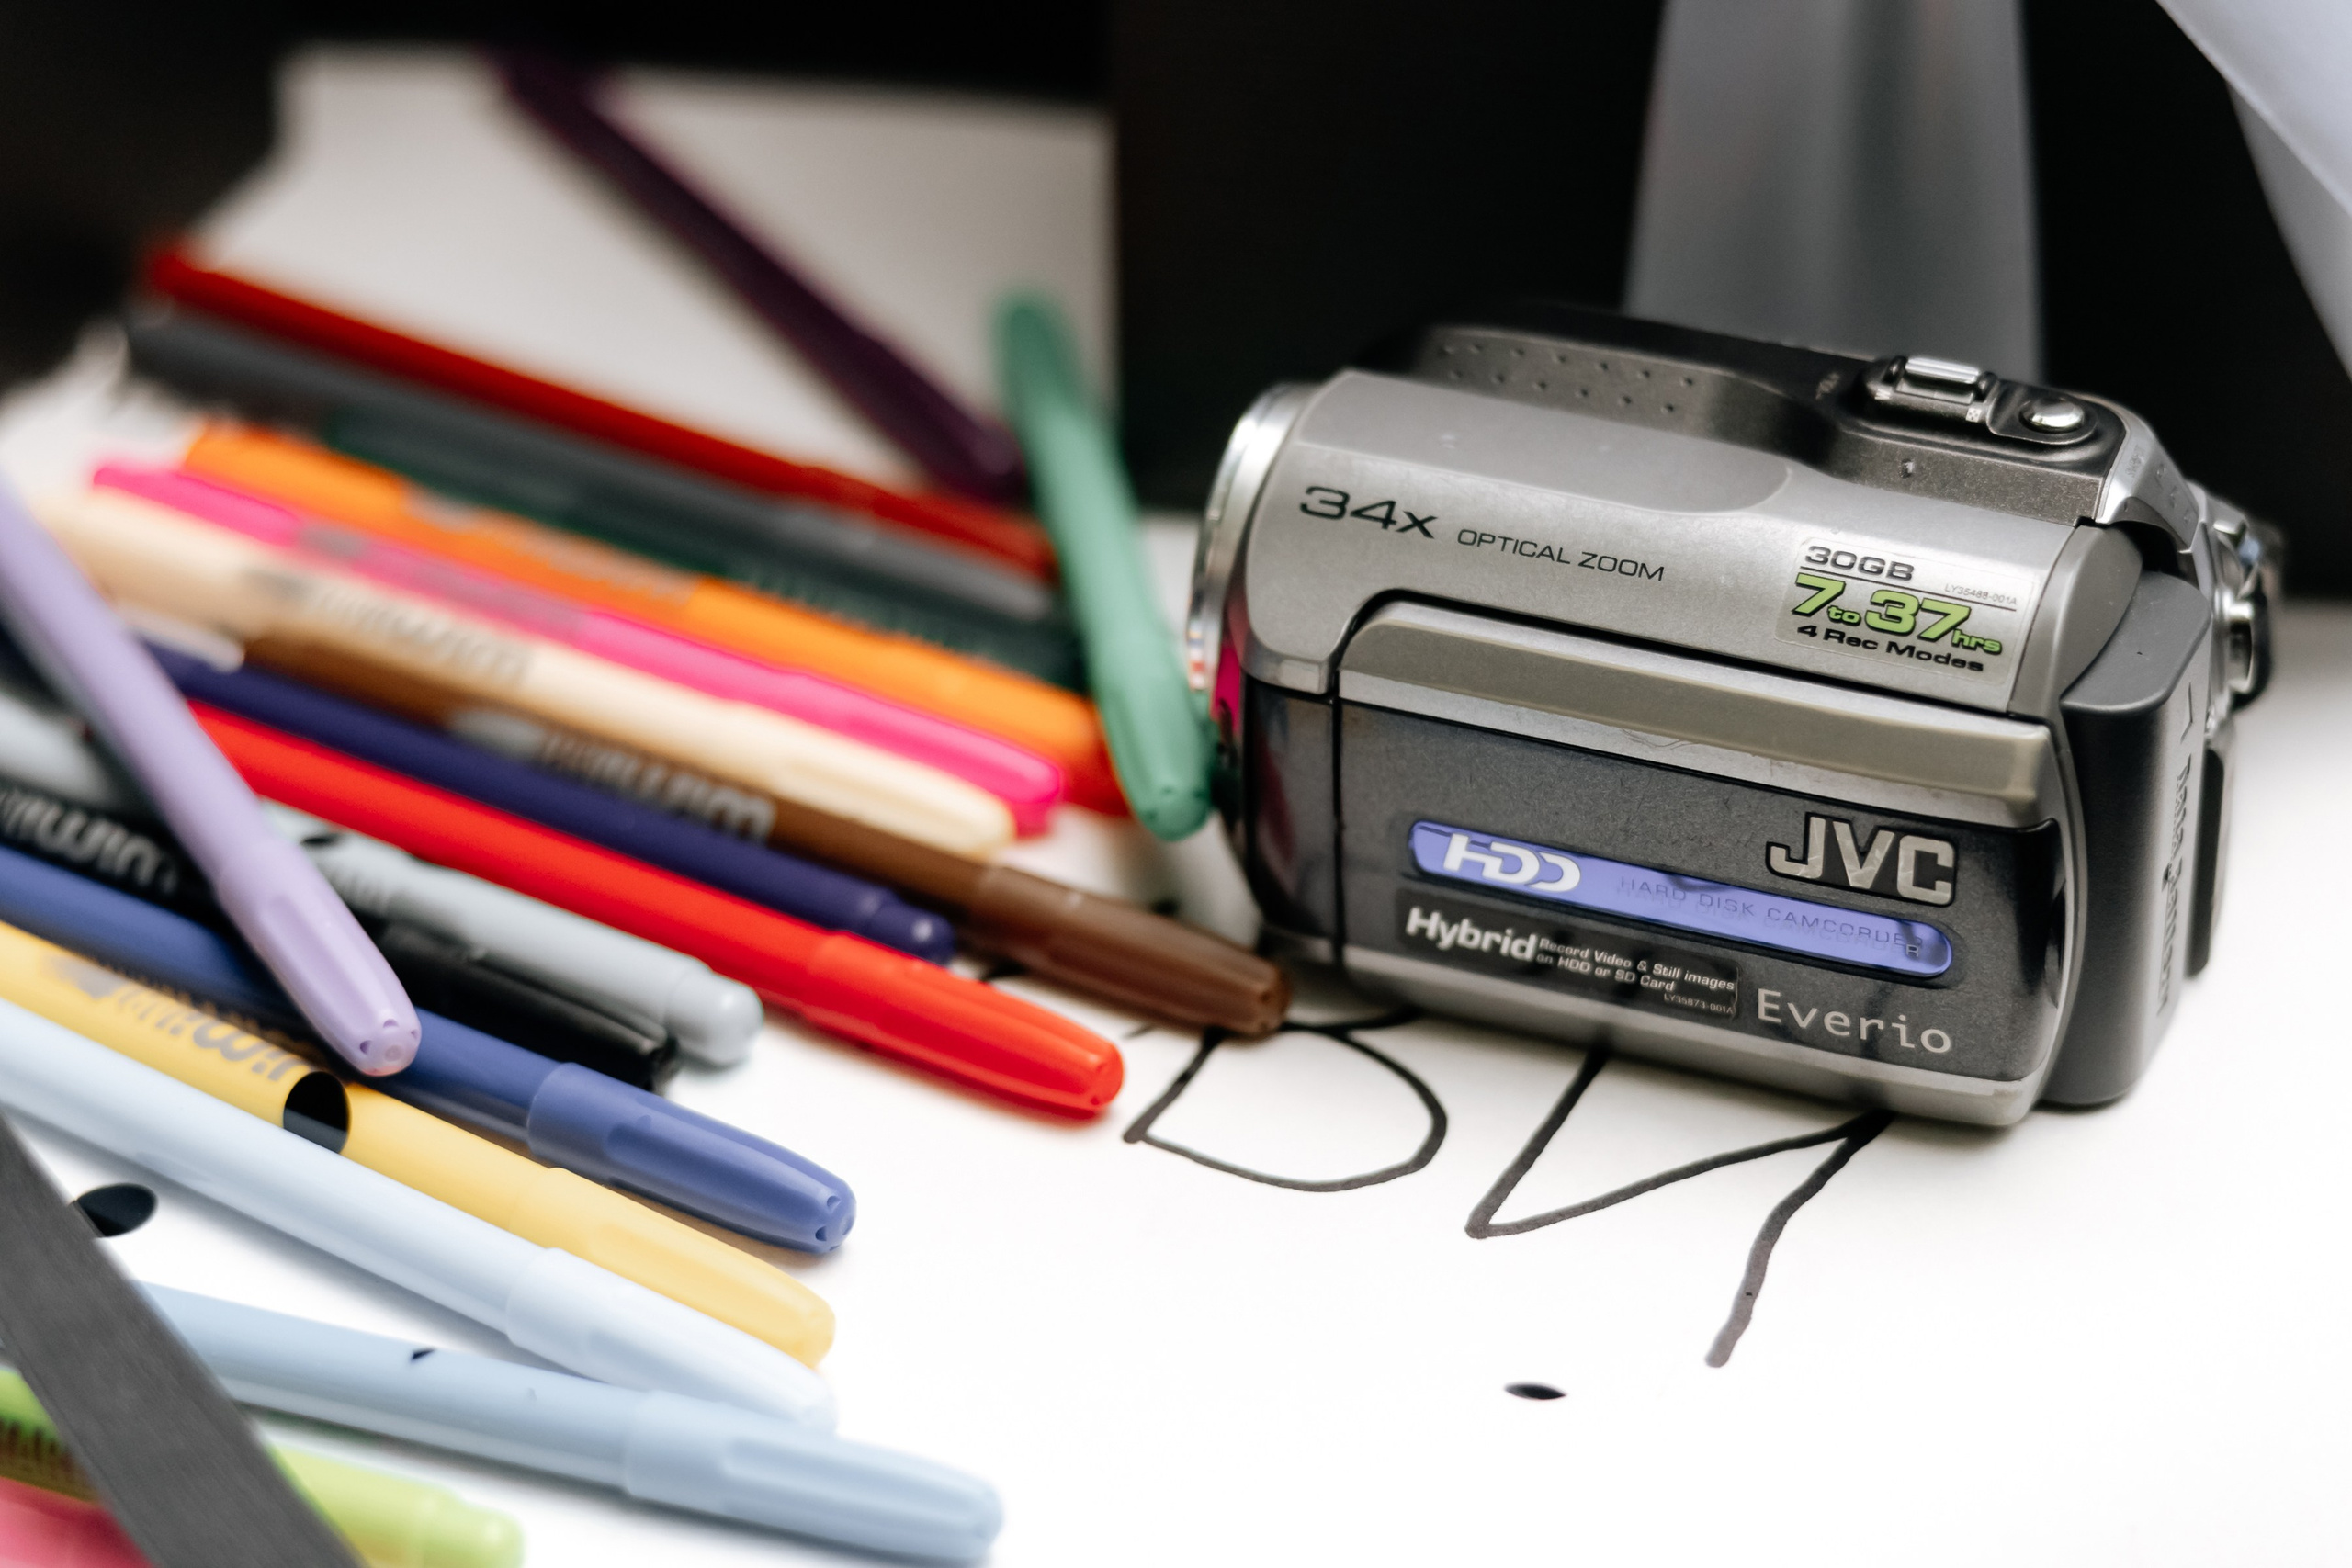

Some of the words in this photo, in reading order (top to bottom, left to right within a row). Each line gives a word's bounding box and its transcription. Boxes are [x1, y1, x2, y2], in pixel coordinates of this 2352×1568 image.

[1300, 486, 1438, 539] 34x
[1457, 528, 1571, 565] OPTICAL
[1577, 551, 1665, 581] ZOOM
[1804, 545, 1915, 581] 30GB
[1792, 572, 1847, 617] 7
[1826, 604, 1862, 626] to
[1865, 589, 1972, 643] 37
[1951, 629, 2003, 655] hrs
[1944, 583, 2017, 606] LY35488-001A
[1797, 625, 1818, 638] 4
[1823, 628, 1879, 650] Rec
[1886, 641, 1984, 672] Modes
[1442, 833, 1581, 892] HDD
[1769, 816, 1954, 906] JVC
[1621, 875, 1687, 902] HARD
[1700, 893, 1755, 917] DISK
[1406, 906, 1537, 963] Hybrid
[1536, 953, 1553, 964] on
[1557, 956, 1591, 973] HDD
[1594, 965, 1611, 977] or
[1614, 969, 1636, 983] SD
[1640, 975, 1675, 992] Card
[1539, 938, 1590, 959] Record
[1594, 950, 1632, 968] Video
[1637, 960, 1647, 972] &
[1653, 964, 1680, 979] Still
[1684, 970, 1735, 991] images
[1758, 988, 1951, 1054] Everio
